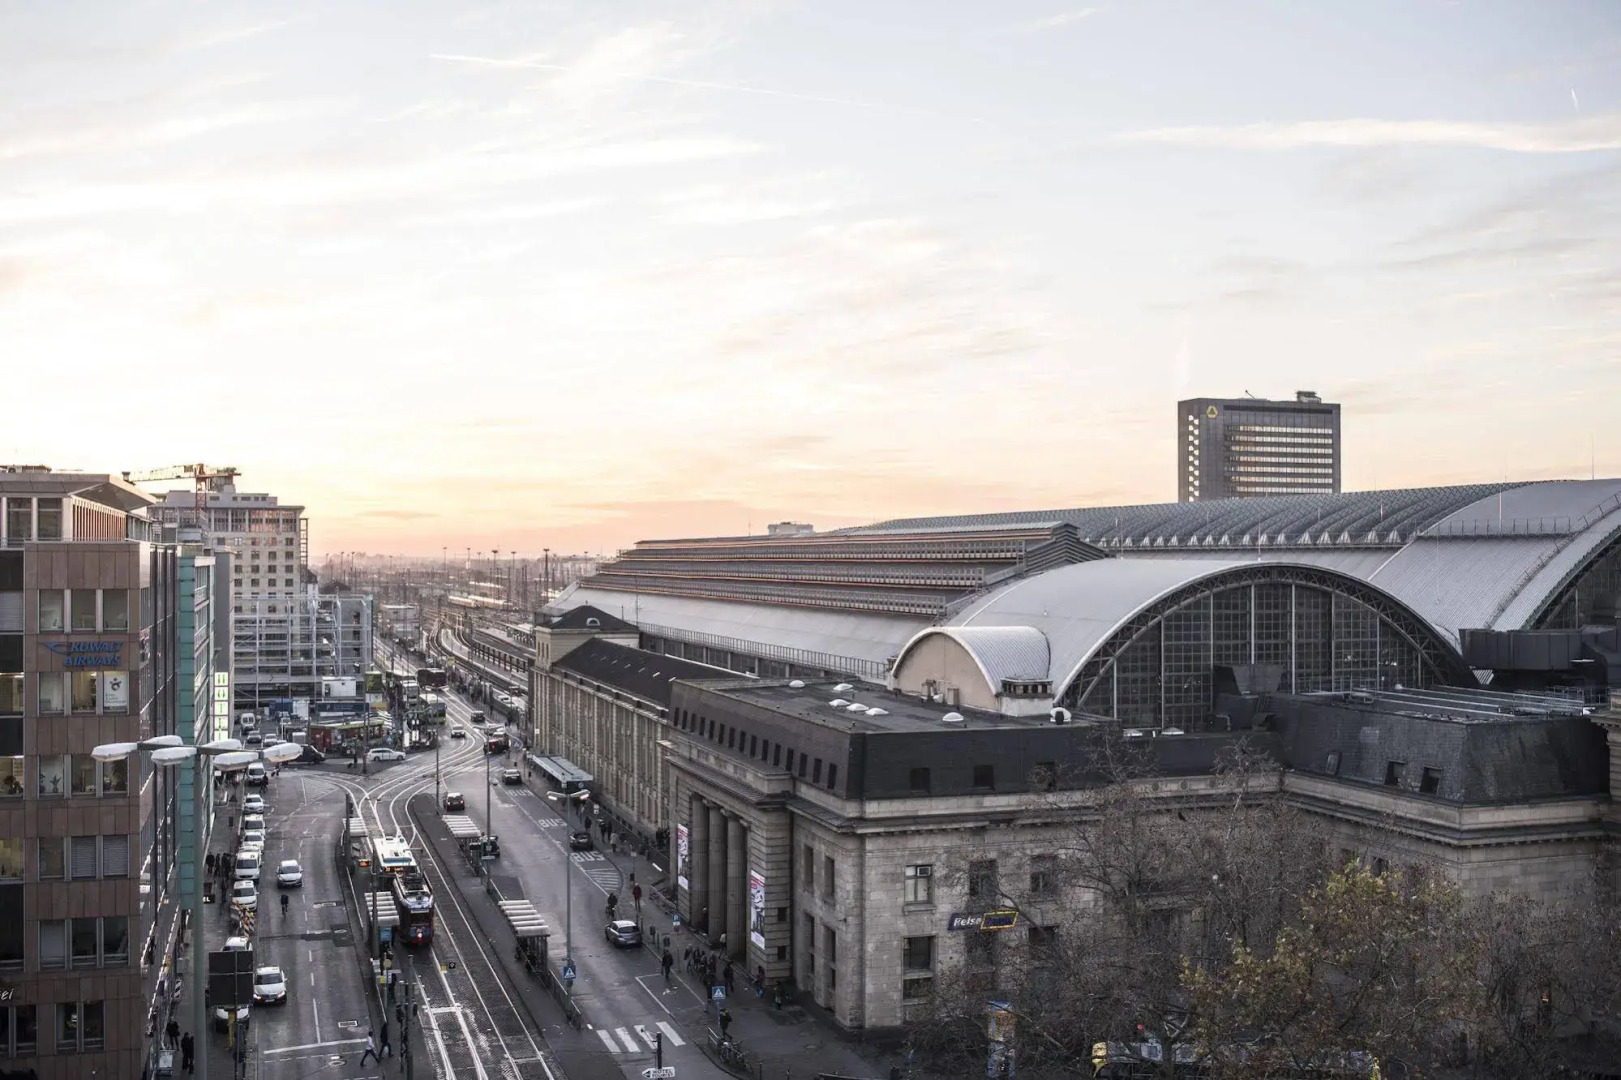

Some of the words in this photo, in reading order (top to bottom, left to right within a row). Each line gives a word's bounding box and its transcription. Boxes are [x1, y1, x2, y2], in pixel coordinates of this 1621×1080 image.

[71, 641, 123, 652] KUWAIT
[63, 655, 120, 667] AIRWAYS
[538, 818, 568, 828] BUS
[569, 851, 606, 862] BUS
[953, 915, 983, 927] Reise
